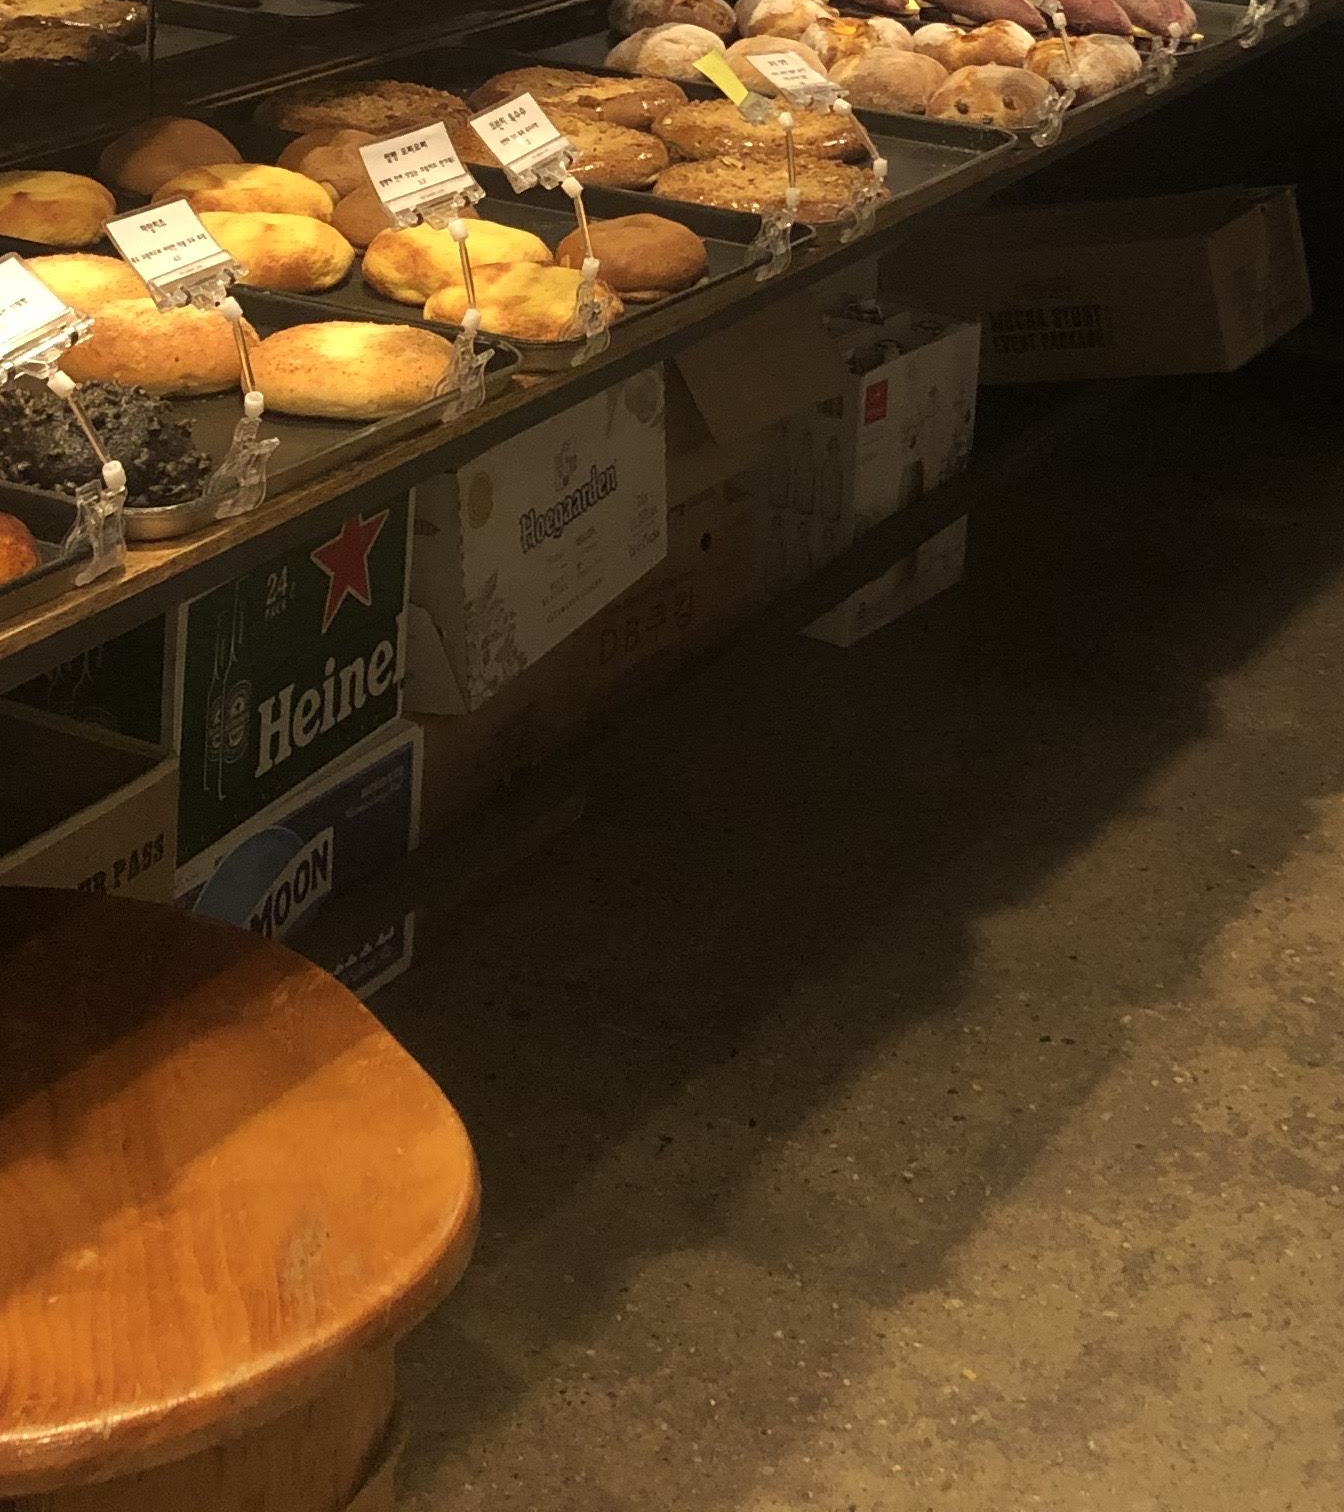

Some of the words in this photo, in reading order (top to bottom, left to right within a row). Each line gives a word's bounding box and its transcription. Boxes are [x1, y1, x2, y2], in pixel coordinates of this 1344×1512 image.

[518, 463, 618, 554] Hoegaarden
[266, 565, 289, 606] 24
[250, 839, 331, 938] MOON
